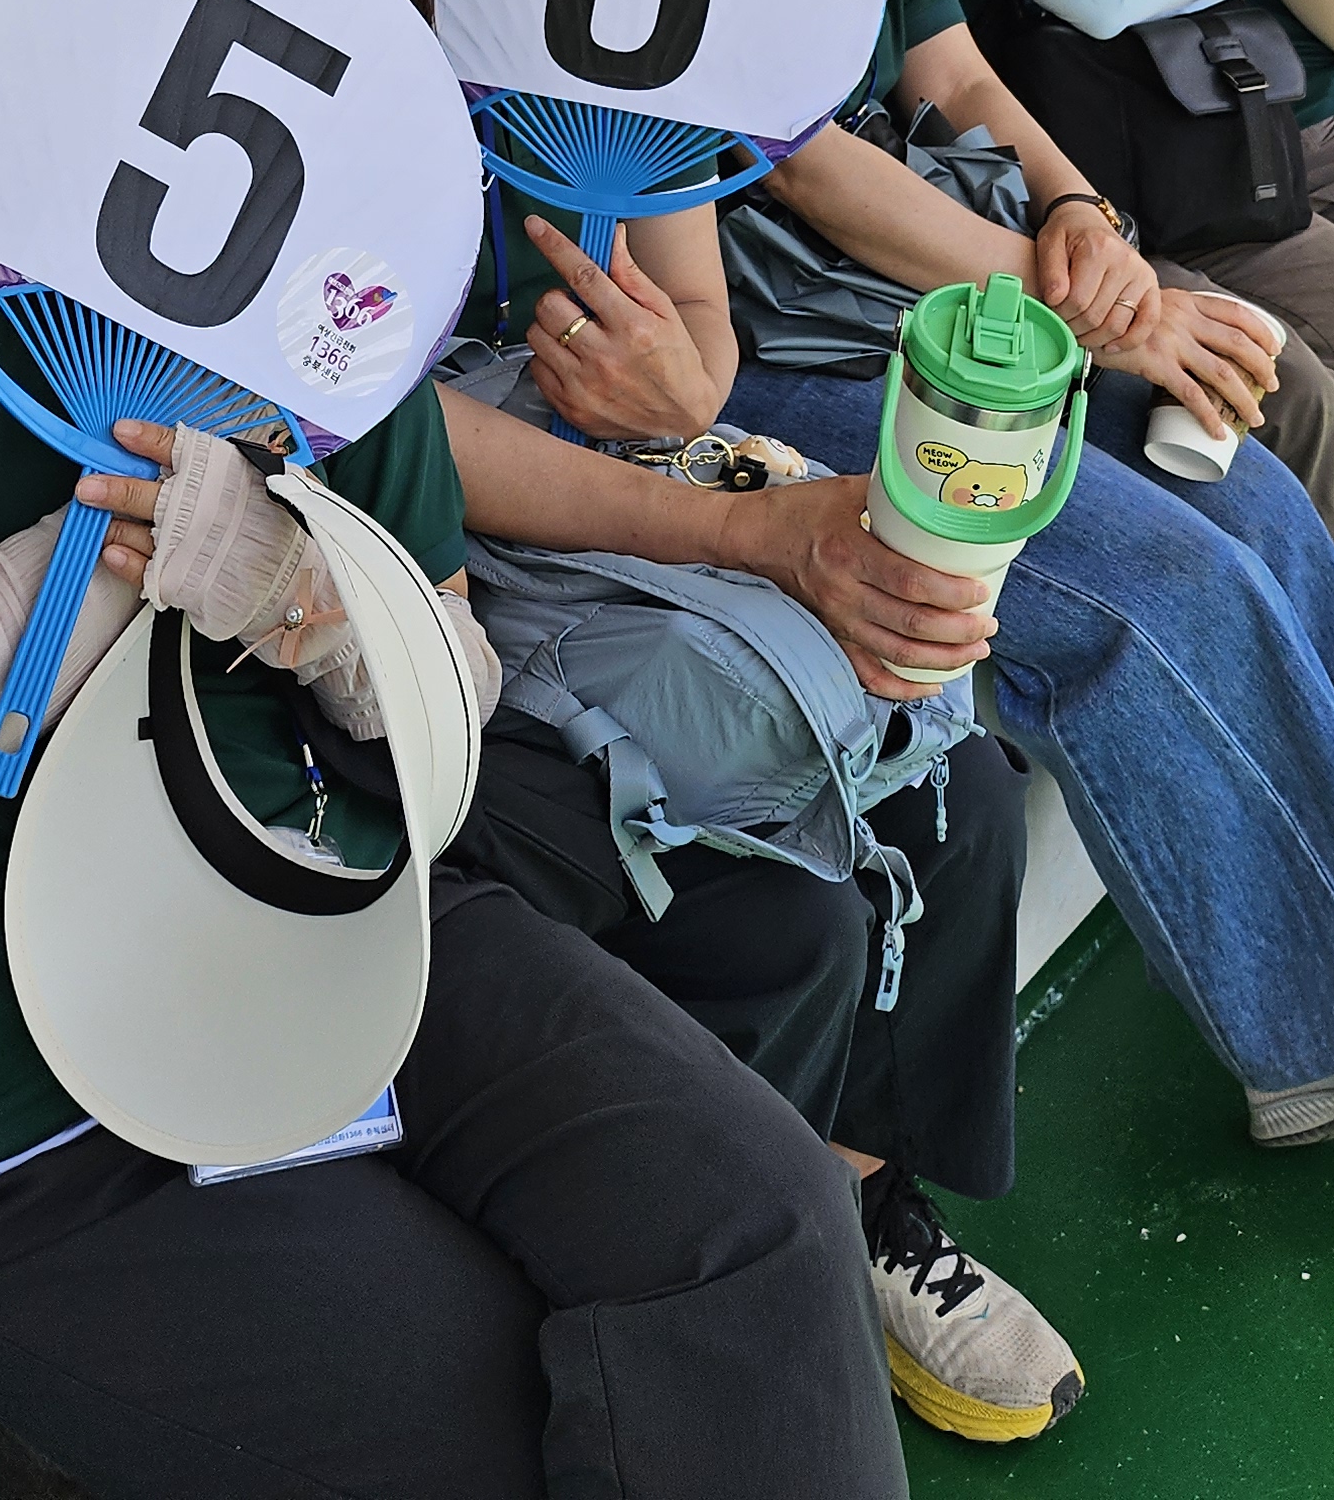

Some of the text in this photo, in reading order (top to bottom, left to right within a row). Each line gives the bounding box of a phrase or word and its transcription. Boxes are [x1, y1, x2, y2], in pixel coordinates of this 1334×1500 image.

[326, 288, 374, 326] 1366
[310, 335, 352, 372] 1366
[317, 323, 357, 354] 여성긴급전화
[302, 355, 341, 385] 충북센터
[922, 446, 953, 459] MEOW
[927, 456, 959, 468] MEOW
